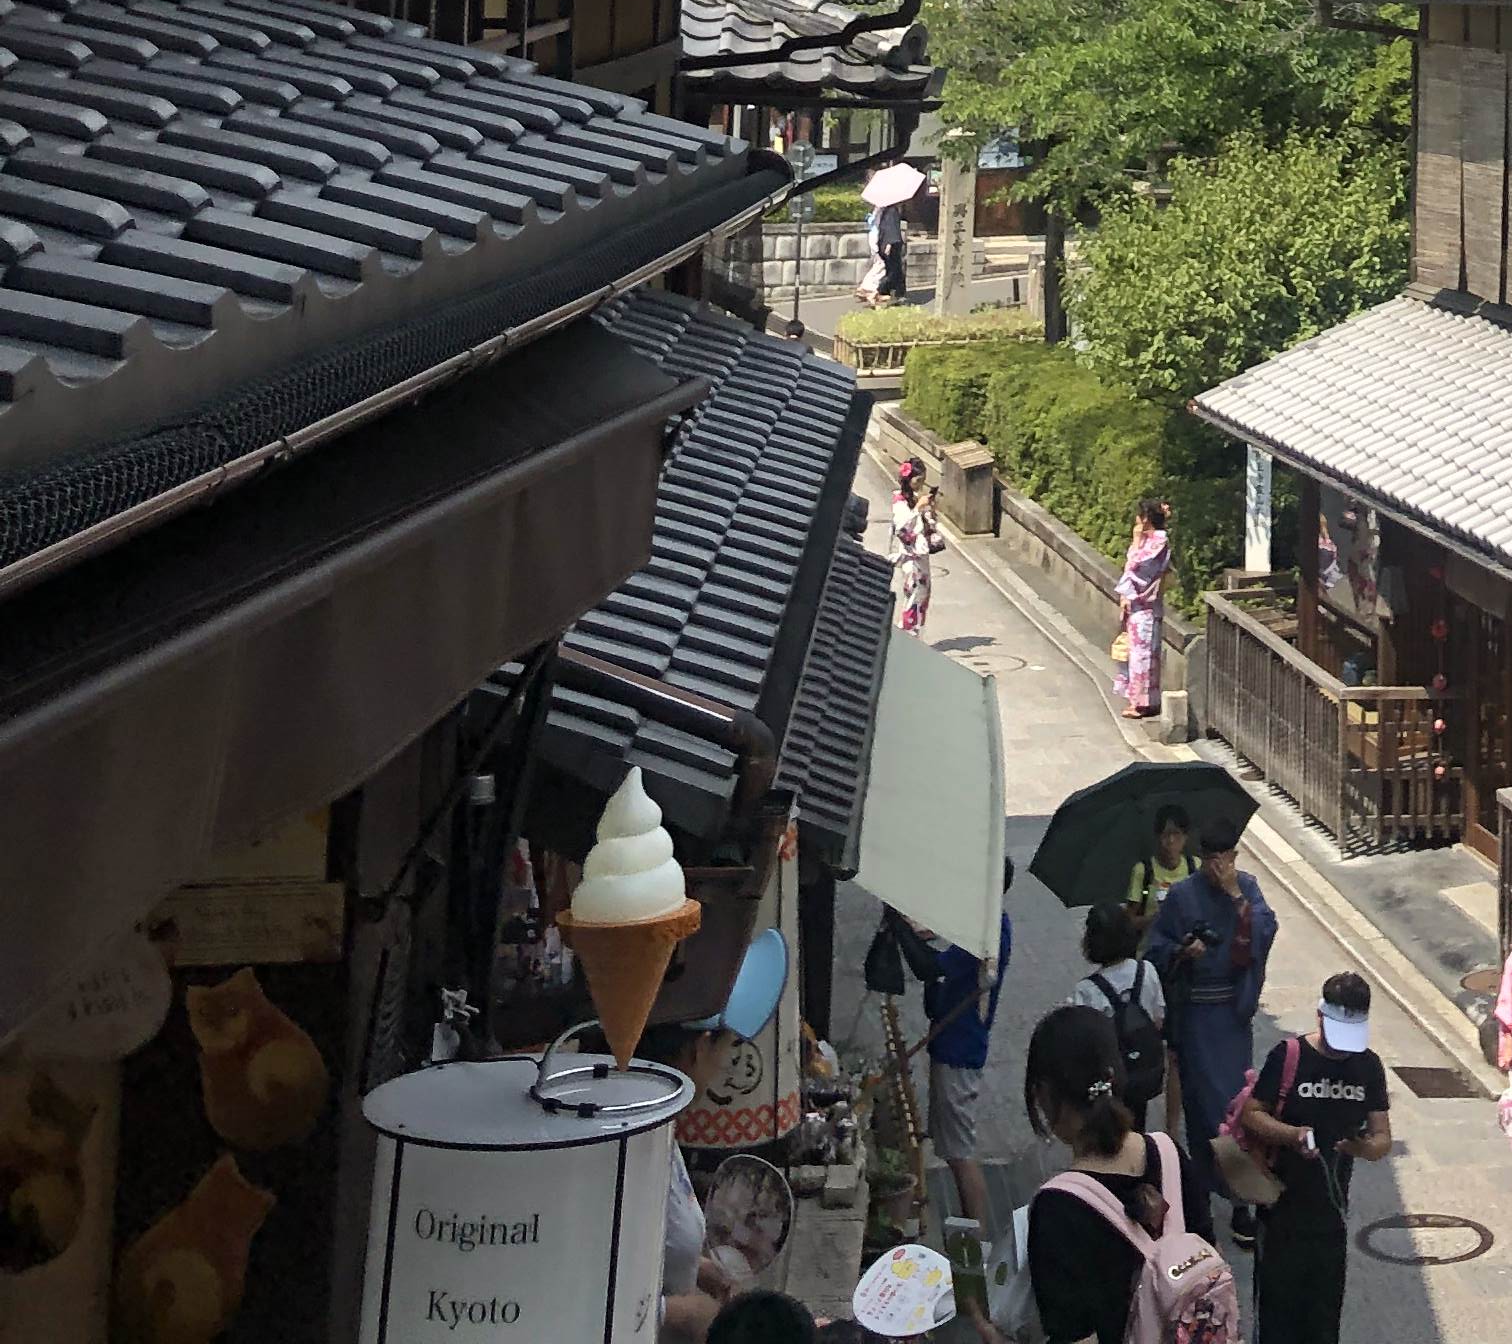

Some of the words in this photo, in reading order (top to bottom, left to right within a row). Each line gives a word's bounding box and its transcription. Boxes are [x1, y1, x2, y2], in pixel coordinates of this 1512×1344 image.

[1298, 1078, 1366, 1102] adidas
[415, 1208, 540, 1253] Original
[425, 1289, 522, 1330] Kyoto
